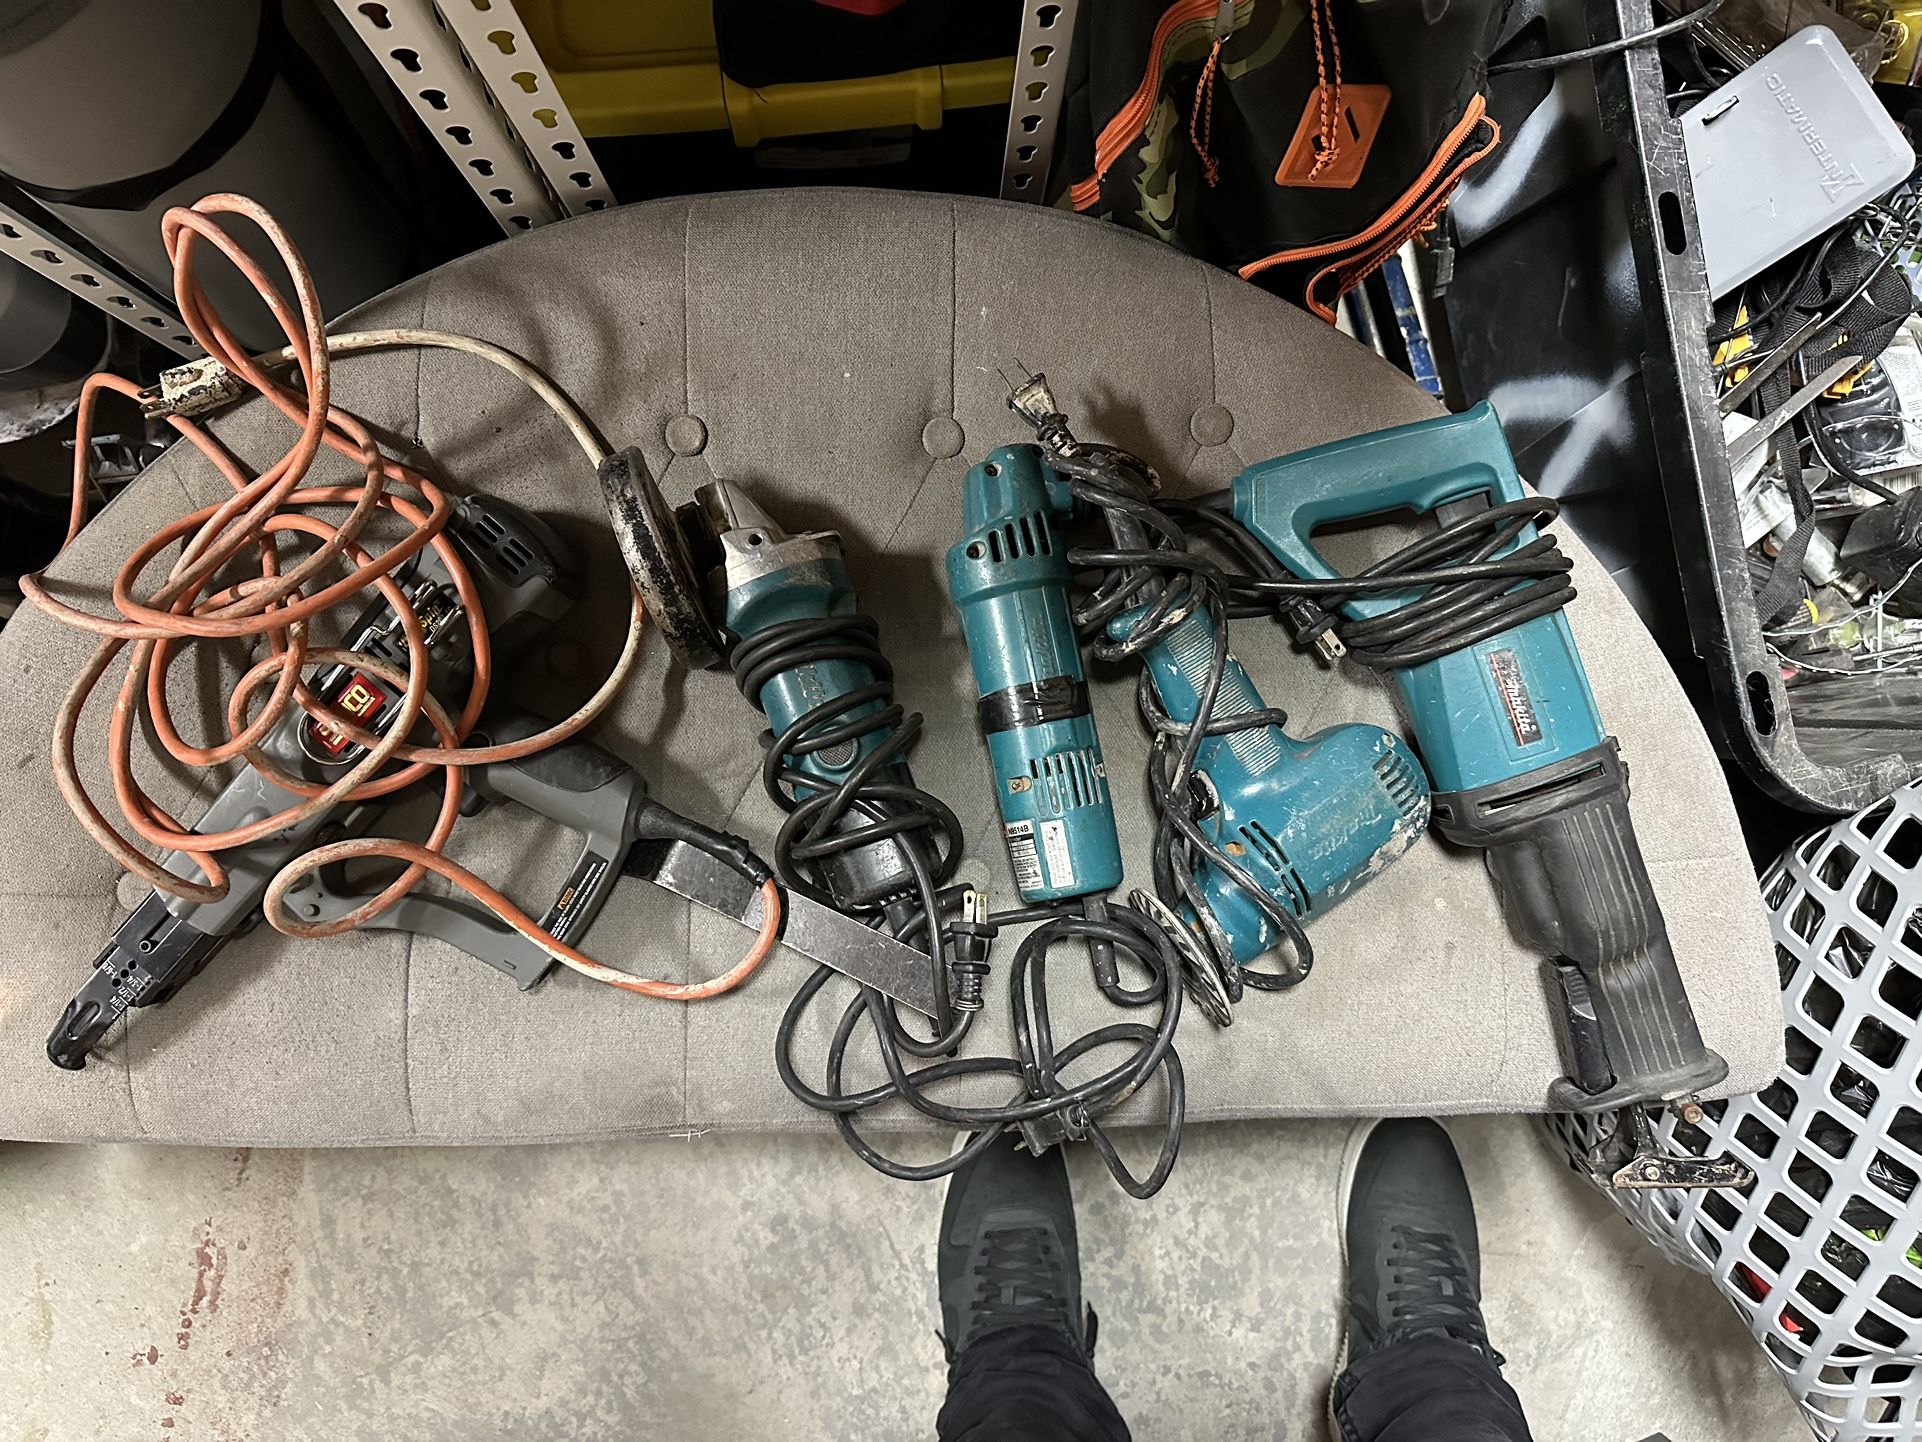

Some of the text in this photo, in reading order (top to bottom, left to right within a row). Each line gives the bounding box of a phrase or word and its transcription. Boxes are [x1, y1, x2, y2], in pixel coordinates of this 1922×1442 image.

[1765, 72, 1866, 203] INTERMATIC
[126, 975, 144, 991] 1-3/4
[118, 986, 134, 1001] 1-1/2
[110, 996, 125, 1010] 1-1/4
